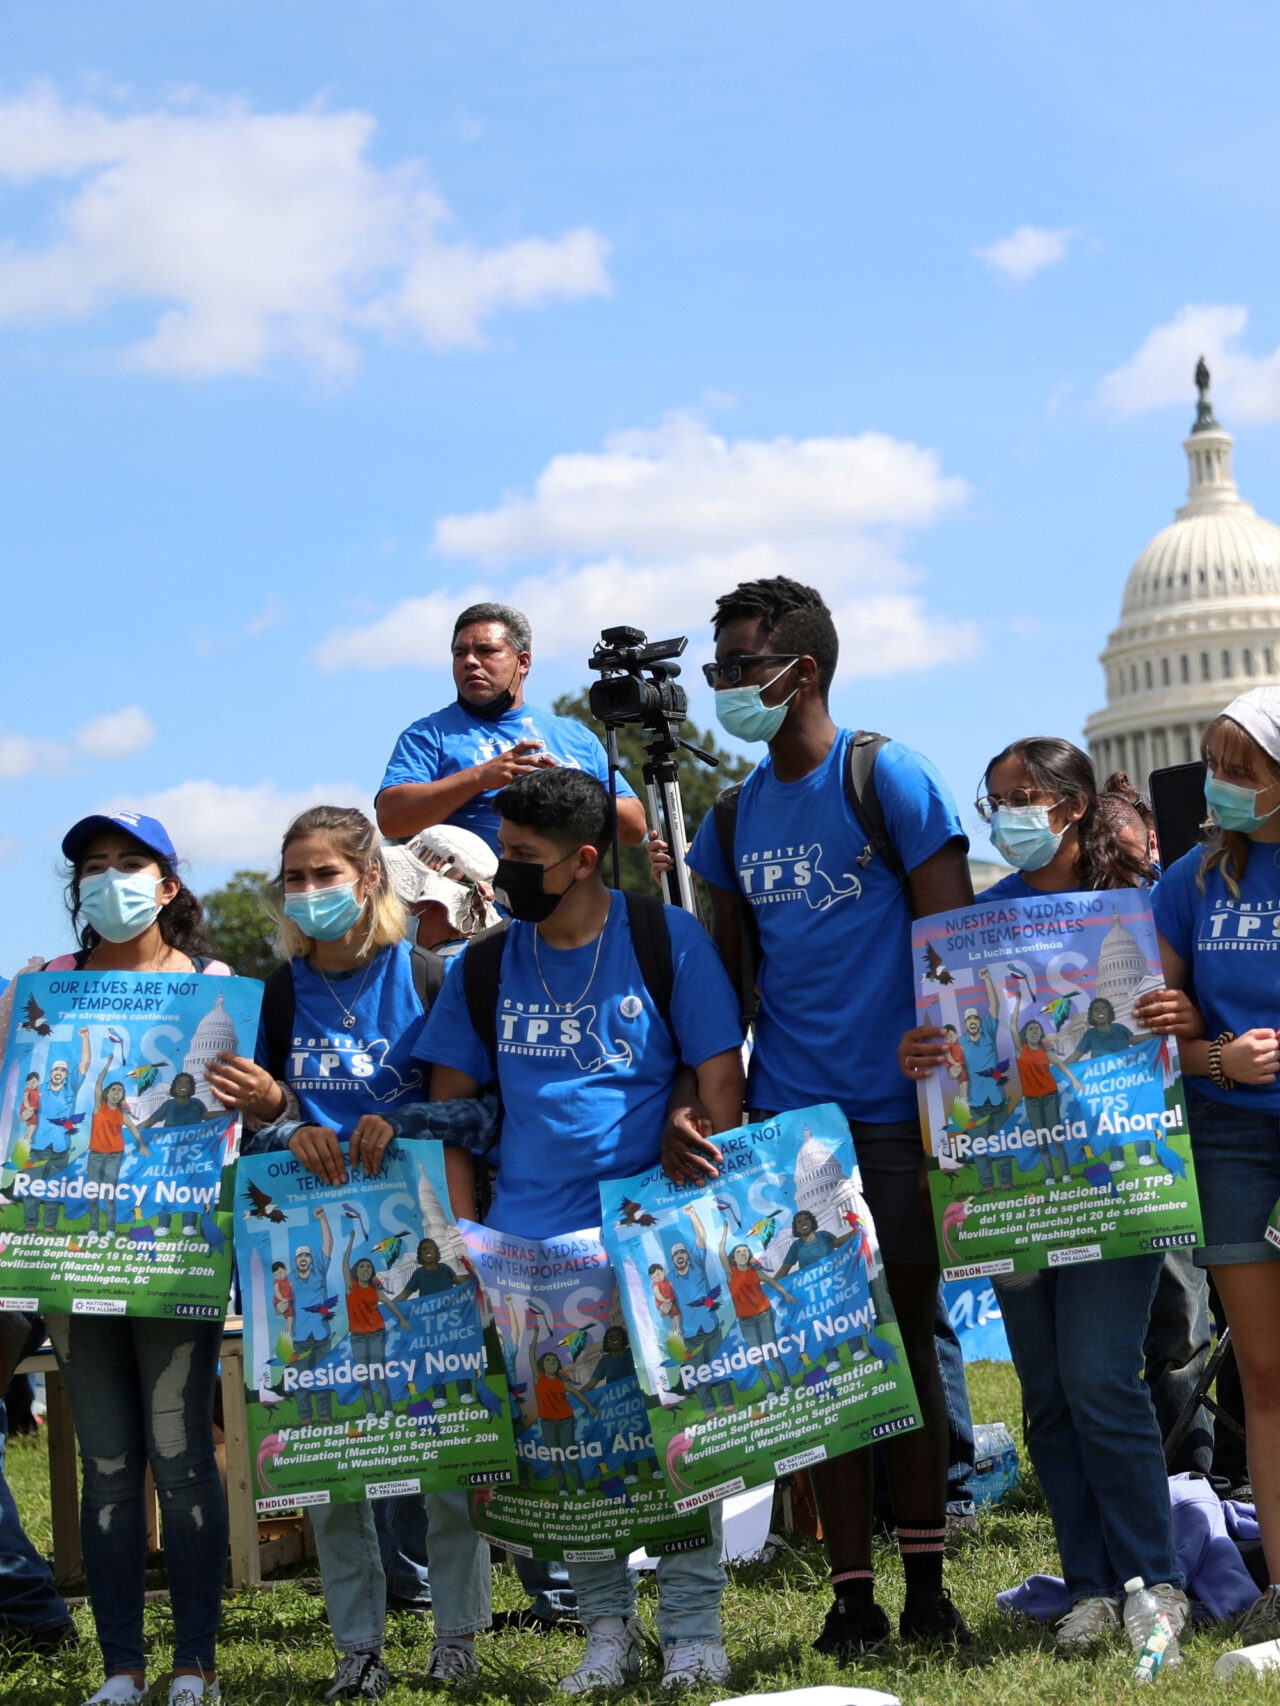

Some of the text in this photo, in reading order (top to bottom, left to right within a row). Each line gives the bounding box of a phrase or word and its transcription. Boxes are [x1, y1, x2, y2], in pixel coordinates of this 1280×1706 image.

[742, 845, 805, 863] COMITÉ
[740, 861, 812, 894] TPS
[946, 900, 1103, 933] NUESTRAS VIDAS NO
[947, 919, 1084, 951] SON TEMPORALES
[968, 940, 1063, 961] La lucha continúa
[50, 981, 199, 995] OUR LIVES ARE NOT
[72, 997, 163, 1011] TEMPORARY
[504, 999, 572, 1013] COMITÉ
[79, 1012, 127, 1021] struggles
[130, 1013, 180, 1021] continues
[501, 1015, 581, 1044] TPS
[294, 1037, 364, 1049] COMITÉ
[498, 1044, 566, 1057] SSACHUSETTS
[291, 1052, 374, 1077] TPS
[1083, 1052, 1149, 1080] ALIANZA
[290, 1081, 359, 1090] SACHUSETTS
[1078, 1071, 1154, 1097] NACIONAL
[1088, 1094, 1129, 1117] TPS
[1097, 1105, 1183, 1136] Ahora!
[151, 1125, 225, 1144] NATIONAL
[721, 1124, 781, 1156] ARE NOT
[162, 1143, 203, 1163] TPS
[144, 1161, 213, 1177] ALLIANCE
[268, 1161, 300, 1177] OUR
[13, 1173, 221, 1206] Residency Now!
[310, 1188, 358, 1199] struggles
[362, 1182, 406, 1192] continues
[964, 1174, 1173, 1215] Convención Nacional del TPS
[0, 1232, 210, 1253] National TPS Convention
[482, 1236, 588, 1261] NUESTRAS VIDAS
[1152, 1235, 1196, 1248] CARECEN
[481, 1254, 600, 1279] SON TEMPORALES
[954, 1267, 981, 1277] NDLON
[497, 1276, 579, 1291] La lucha continúa
[176, 1305, 219, 1317] CARECEN
[680, 1298, 877, 1390] Residency Now!
[283, 1346, 488, 1391] Residency Now!
[684, 1360, 883, 1440] National TPS Convention
[278, 1409, 489, 1442] National TPS Convention
[745, 1413, 839, 1453] in Washington, DC
[873, 1416, 914, 1437] CARECEN
[516, 1438, 603, 1462] idencia
[338, 1451, 438, 1470] in Washington, DC
[470, 1472, 511, 1484] CARECEN
[266, 1498, 295, 1508] NDLON
[490, 1490, 652, 1510] Convención Nacional del
[686, 1491, 715, 1509] NDLON
[533, 1531, 545, 1539] en
[548, 1530, 611, 1543] Washington,
[616, 1529, 630, 1537] DC
[664, 1537, 706, 1552] CARECEN
